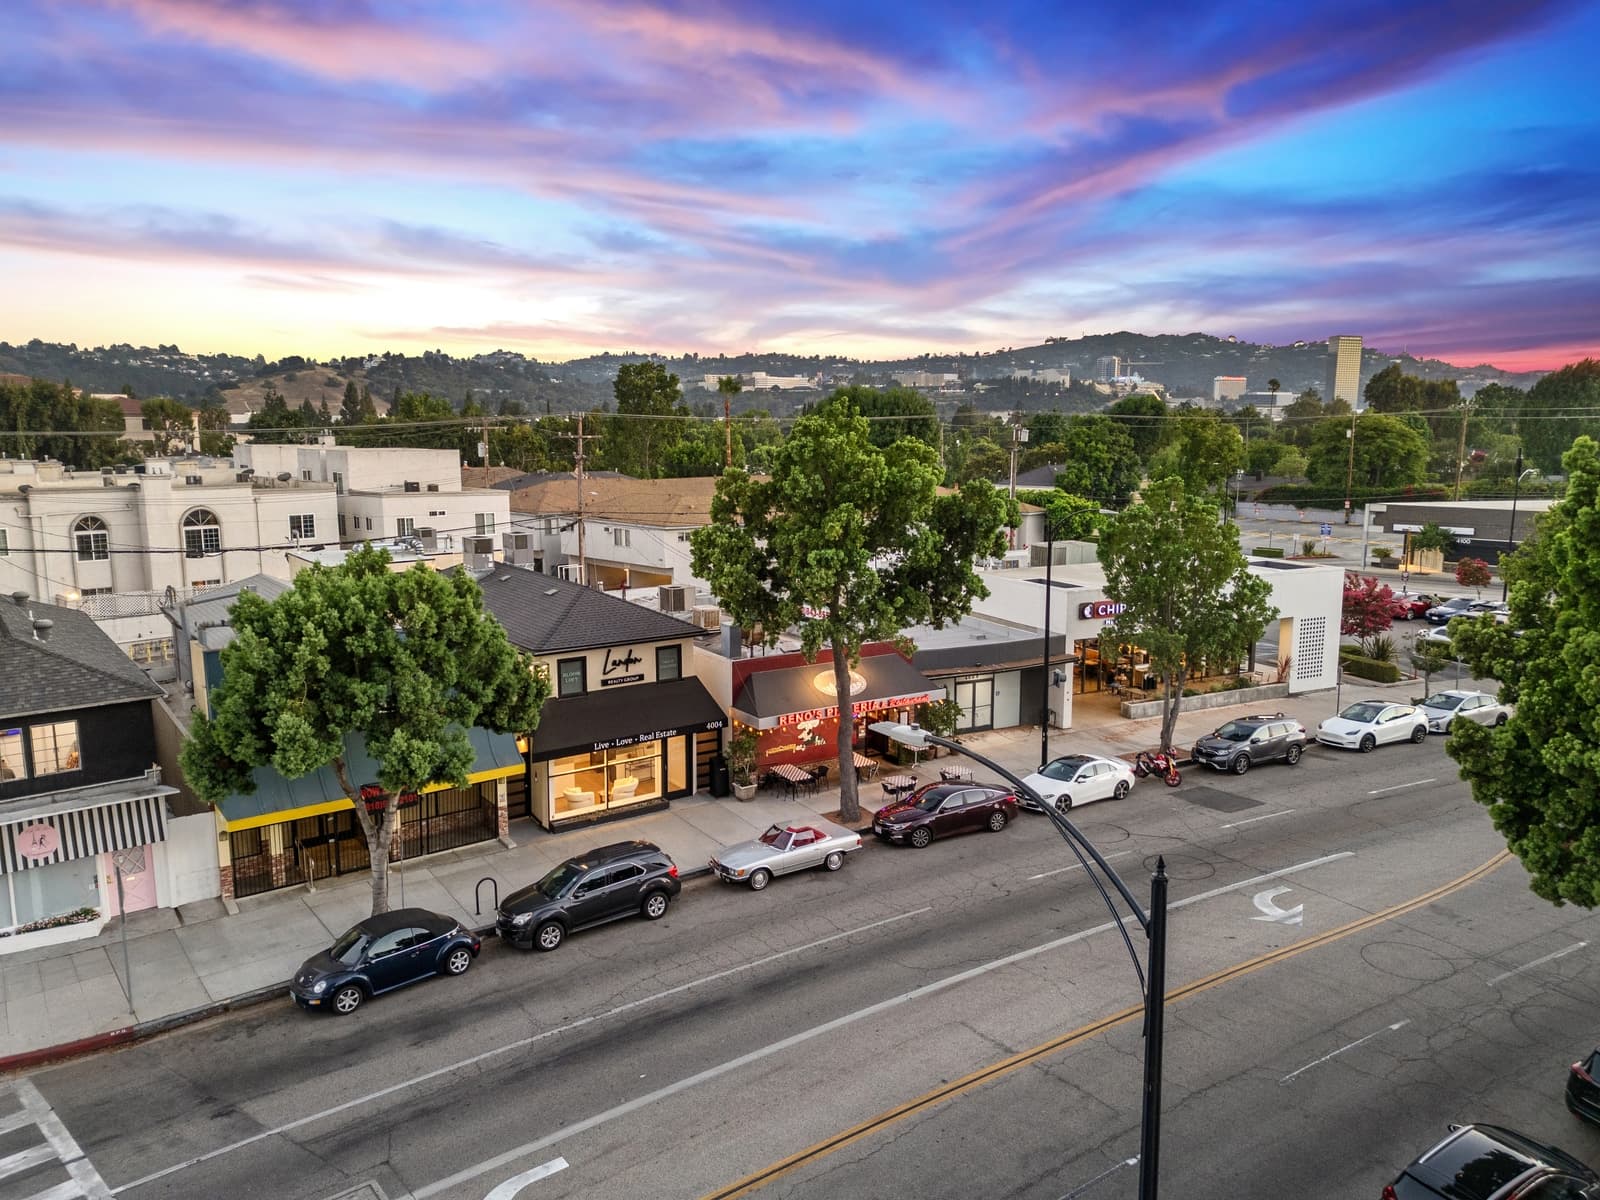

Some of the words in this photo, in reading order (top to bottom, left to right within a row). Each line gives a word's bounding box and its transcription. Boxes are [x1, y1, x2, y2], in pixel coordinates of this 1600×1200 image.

[1098, 603, 1127, 615] CHIP
[779, 709, 822, 726] RENO'S
[826, 701, 880, 718] PIERIA
[706, 720, 723, 729] 4004
[594, 741, 609, 750] Live
[616, 737, 632, 746] Love
[639, 733, 655, 742] Real
[655, 729, 677, 738] Estate
